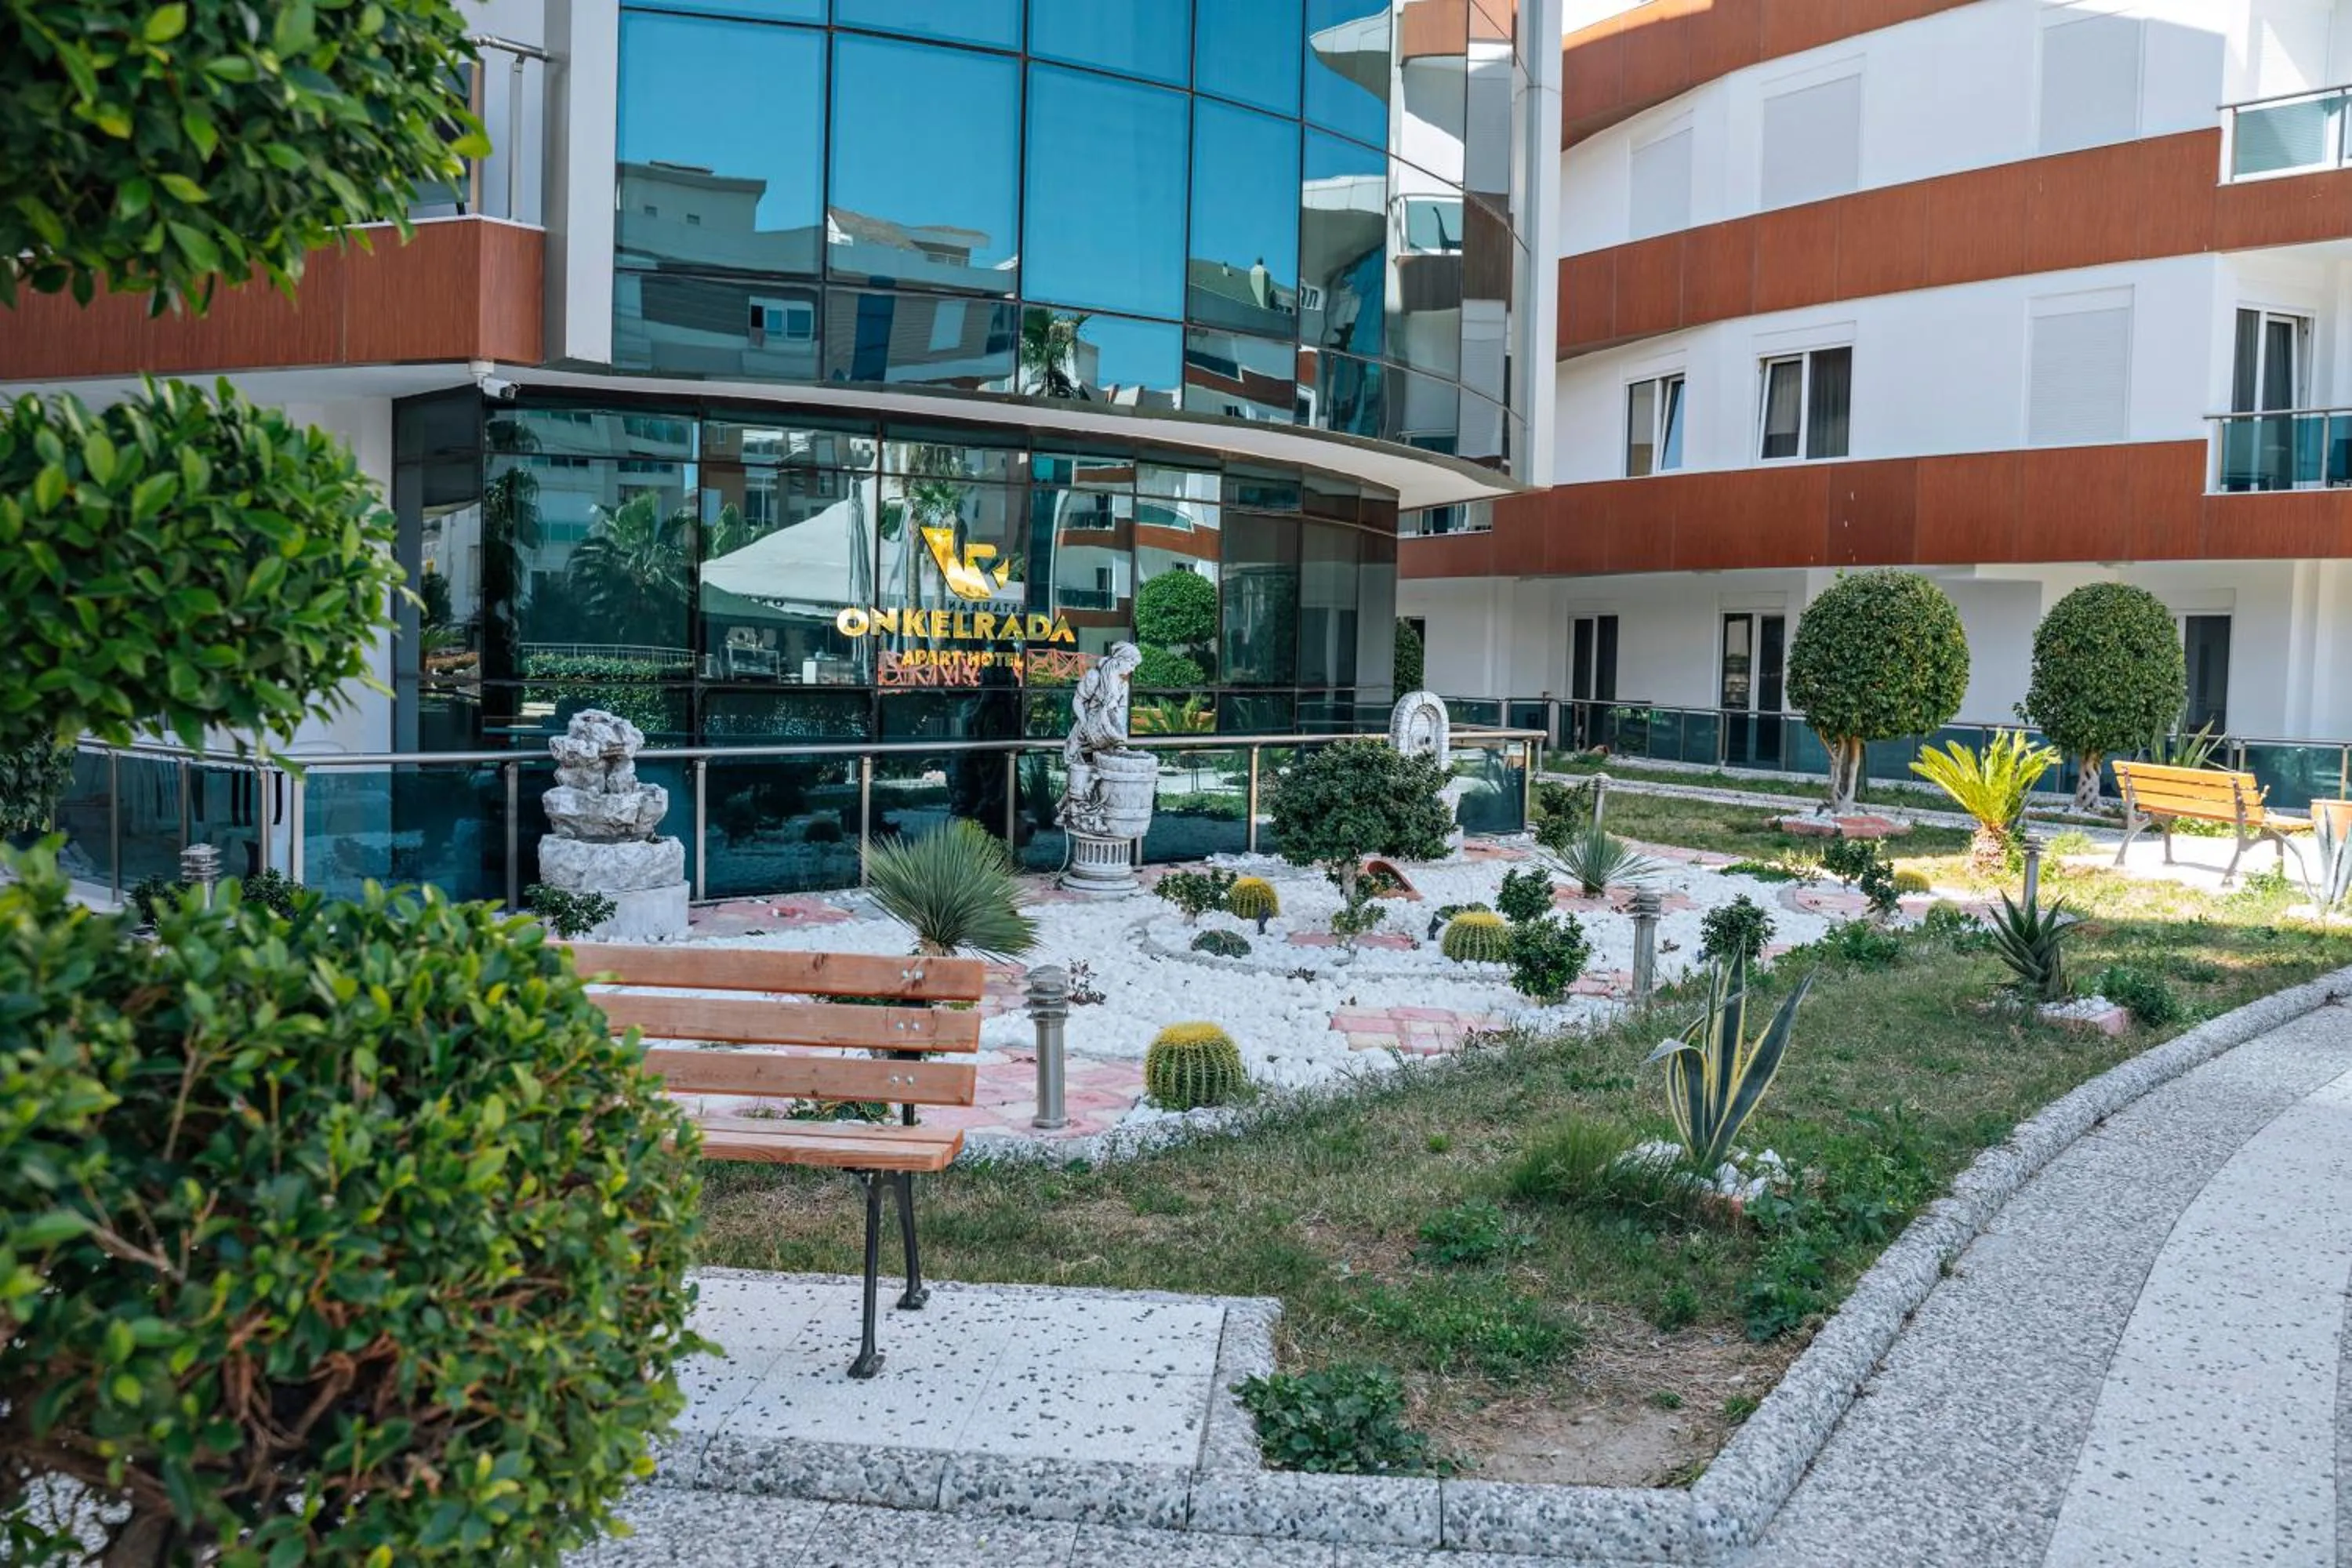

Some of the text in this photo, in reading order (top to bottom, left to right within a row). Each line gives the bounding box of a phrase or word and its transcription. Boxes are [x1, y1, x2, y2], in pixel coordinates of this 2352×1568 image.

[837, 608, 1076, 642] ONKELRADA
[902, 649, 1023, 666] APART HOTEL
